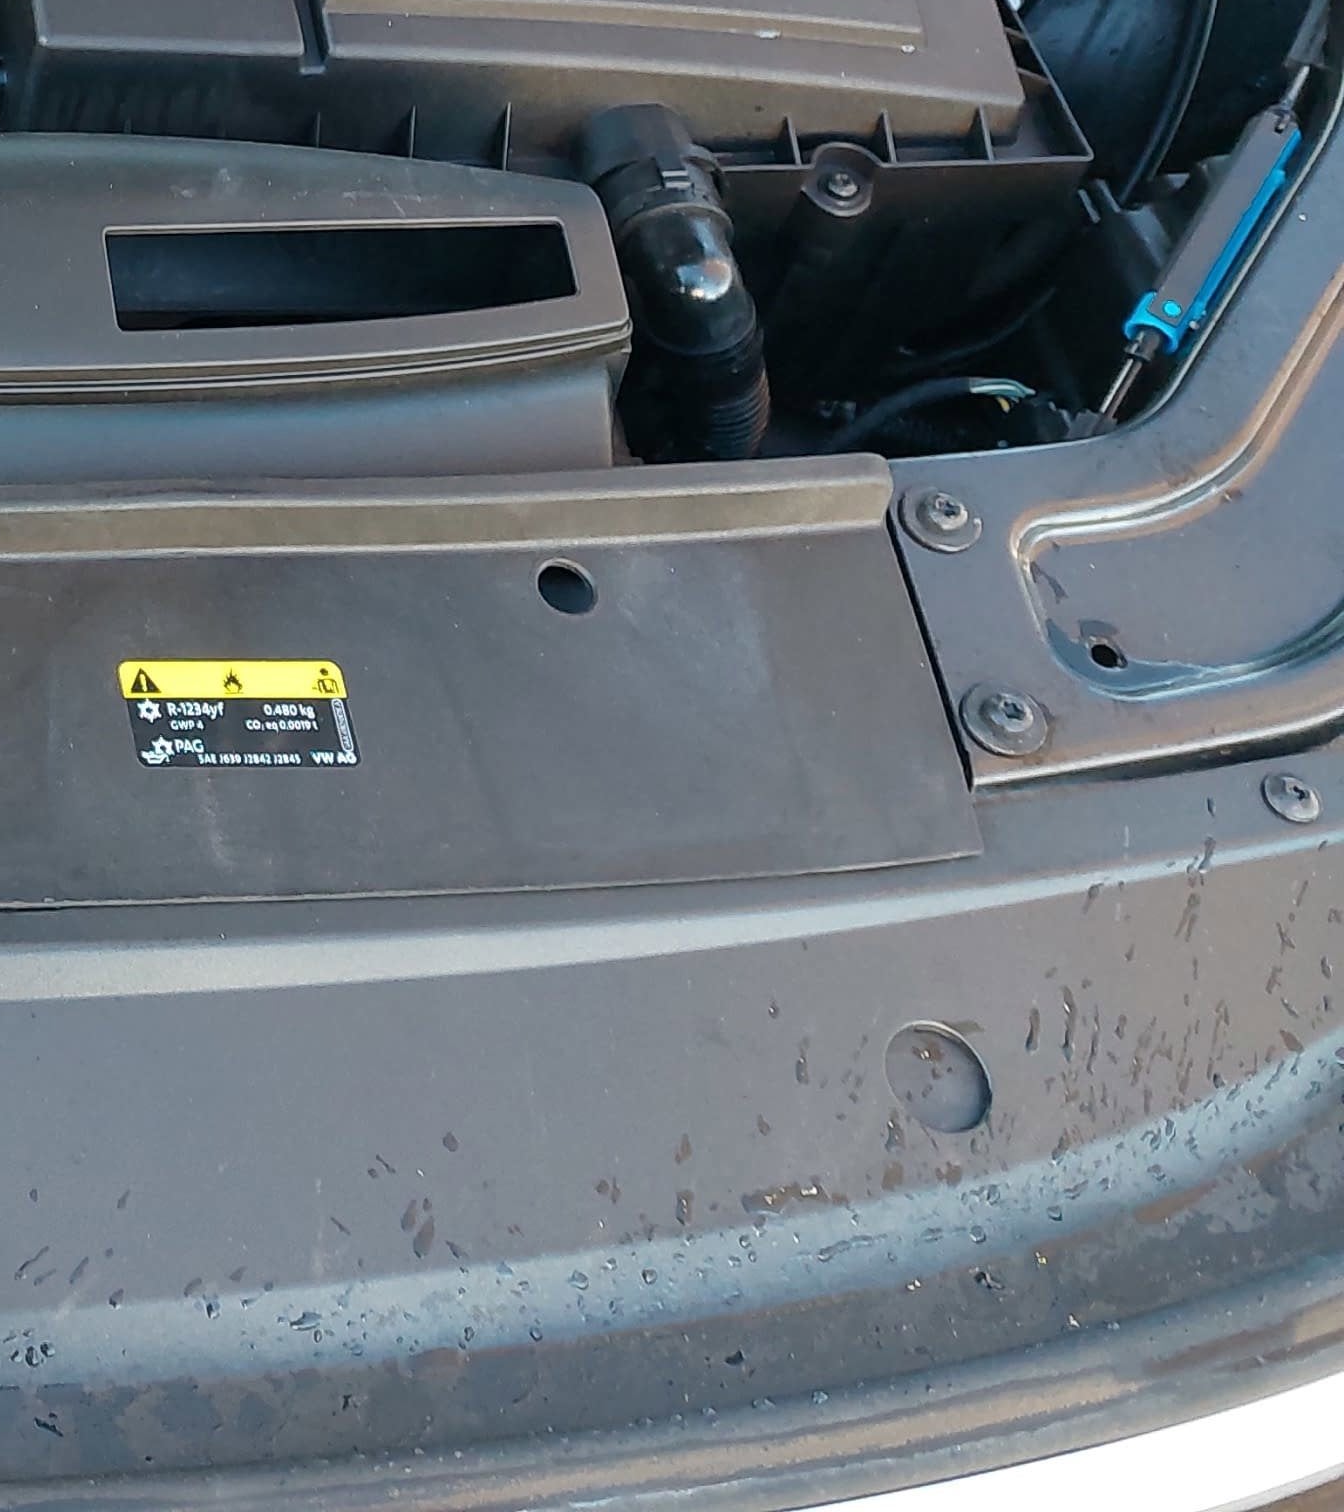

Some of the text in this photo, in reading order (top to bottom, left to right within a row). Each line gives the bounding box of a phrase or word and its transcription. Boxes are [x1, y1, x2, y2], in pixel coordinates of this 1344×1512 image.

[166, 702, 315, 719] R-1234yf 0.480 kg
[171, 722, 195, 730] GWP
[197, 722, 204, 730] 4
[175, 740, 204, 753] PAG
[313, 752, 334, 764] VW
